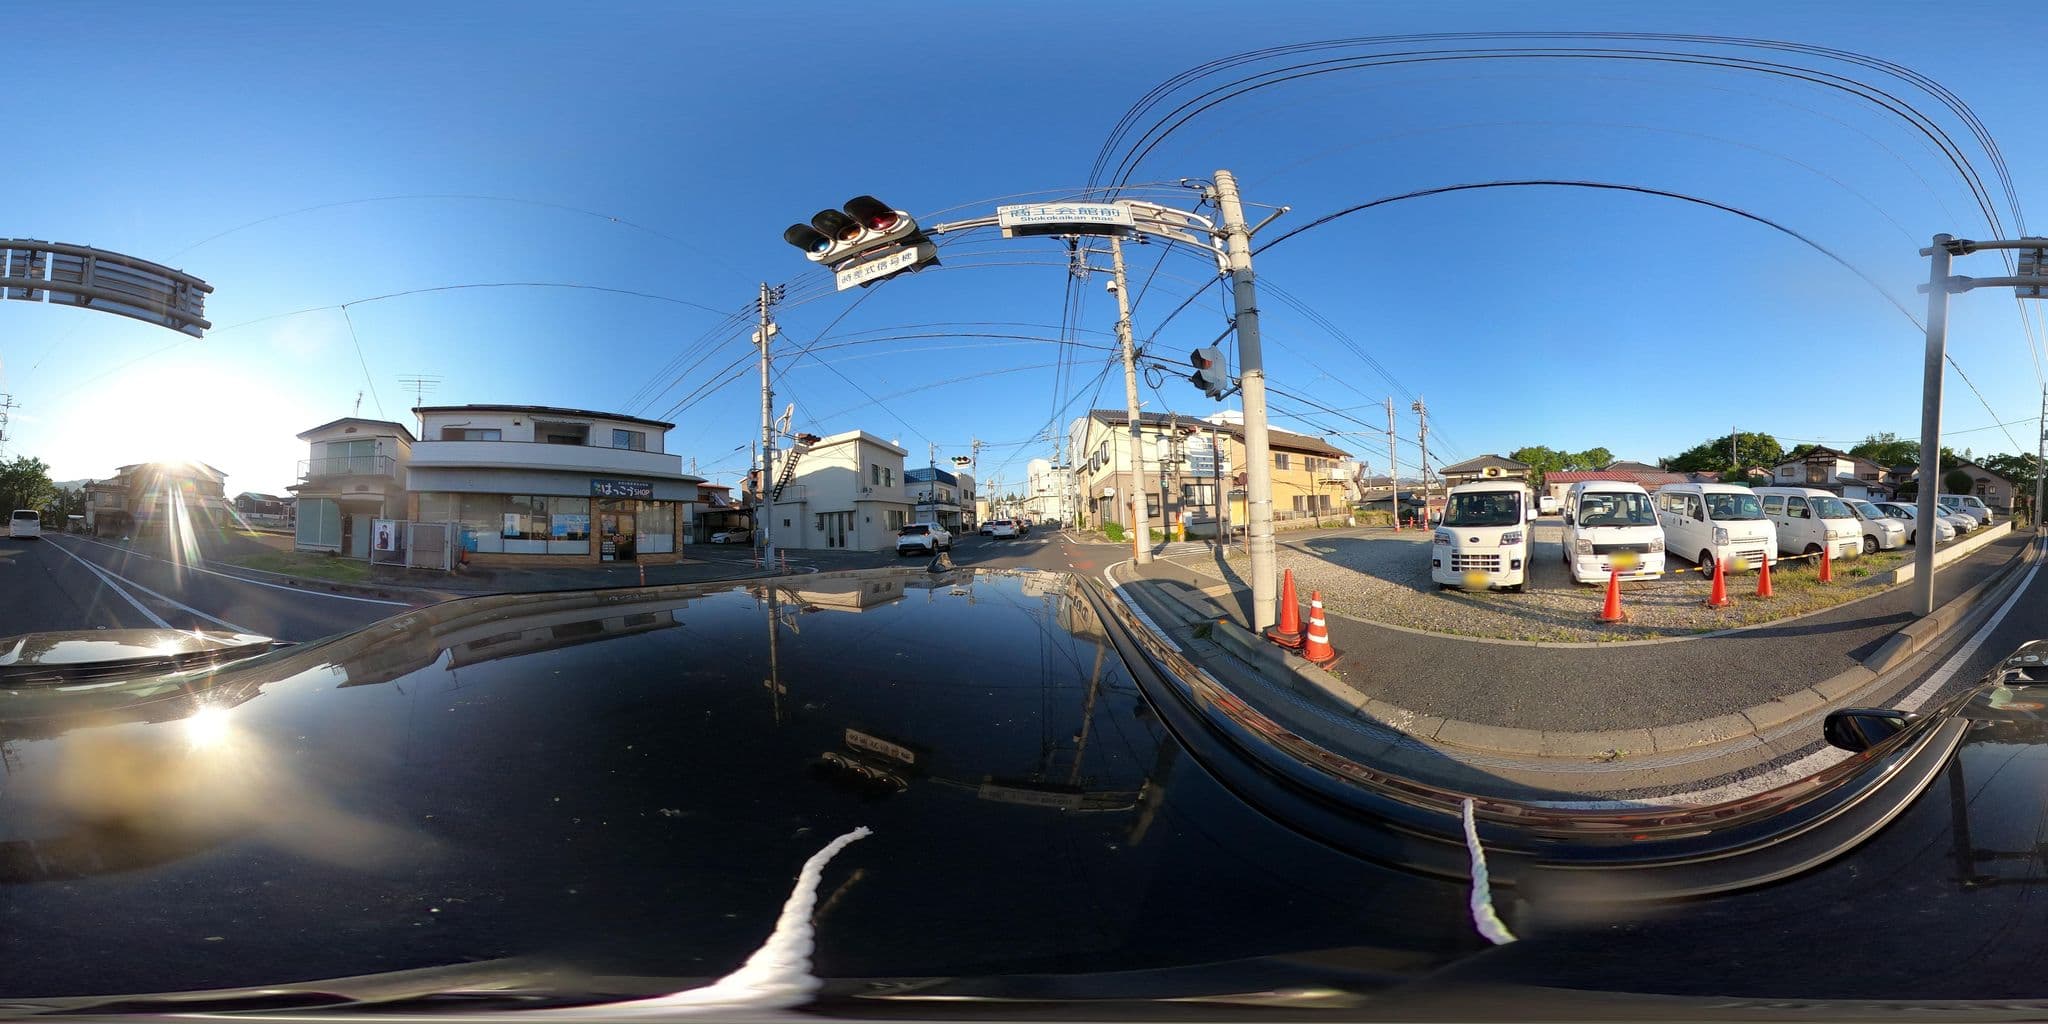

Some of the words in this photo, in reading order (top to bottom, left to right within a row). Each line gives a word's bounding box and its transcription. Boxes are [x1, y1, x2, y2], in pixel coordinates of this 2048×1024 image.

[1010, 207, 1120, 217] 商工会館前
[1020, 214, 1087, 222] Shokokaikan
